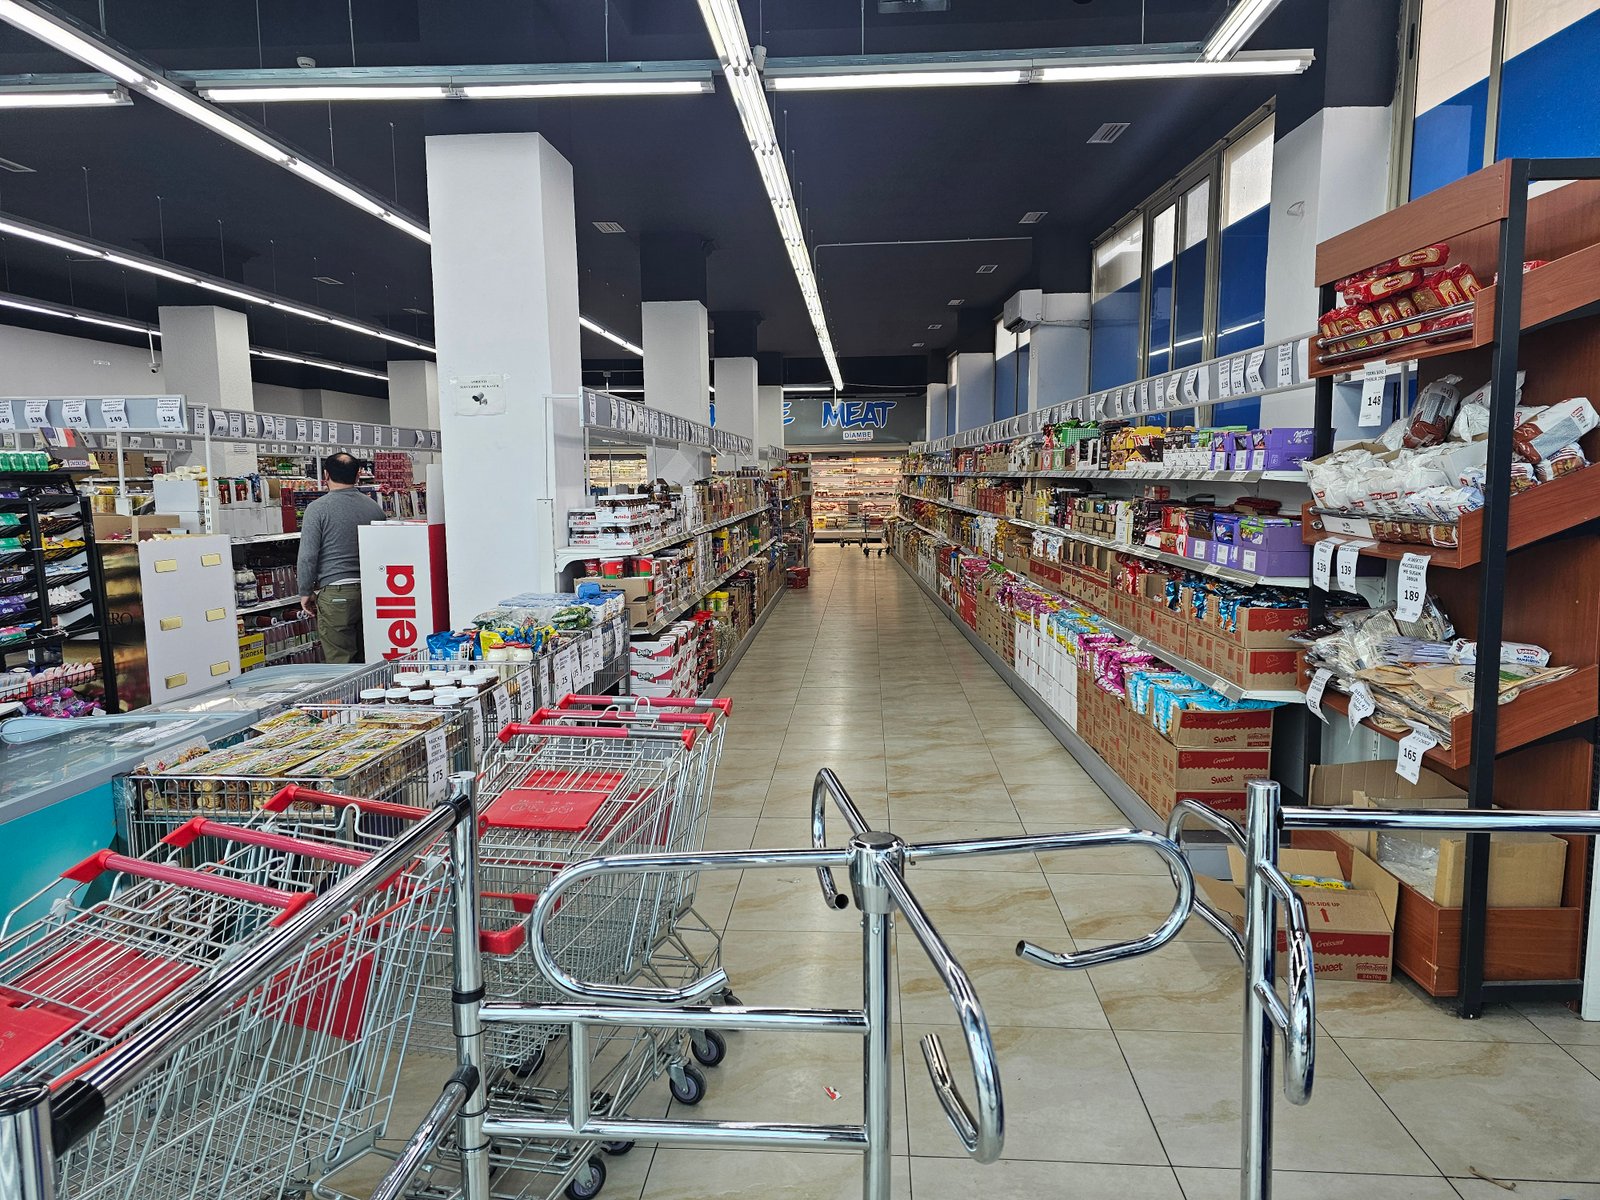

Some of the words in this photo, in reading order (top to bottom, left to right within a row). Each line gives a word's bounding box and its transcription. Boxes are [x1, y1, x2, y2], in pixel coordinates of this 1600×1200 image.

[1367, 395, 1382, 407] 148
[821, 401, 897, 429] MEAT
[1316, 561, 1327, 573] 139
[1341, 565, 1352, 575] 139
[1404, 590, 1419, 602] 189
[382, 564, 419, 662] tella
[240, 648, 264, 660] aionese
[1213, 734, 1238, 745] Sweet
[1403, 748, 1418, 764] 165
[432, 768, 444, 784] 175
[1210, 773, 1235, 786] Sweet
[1313, 962, 1344, 974] Sweet
